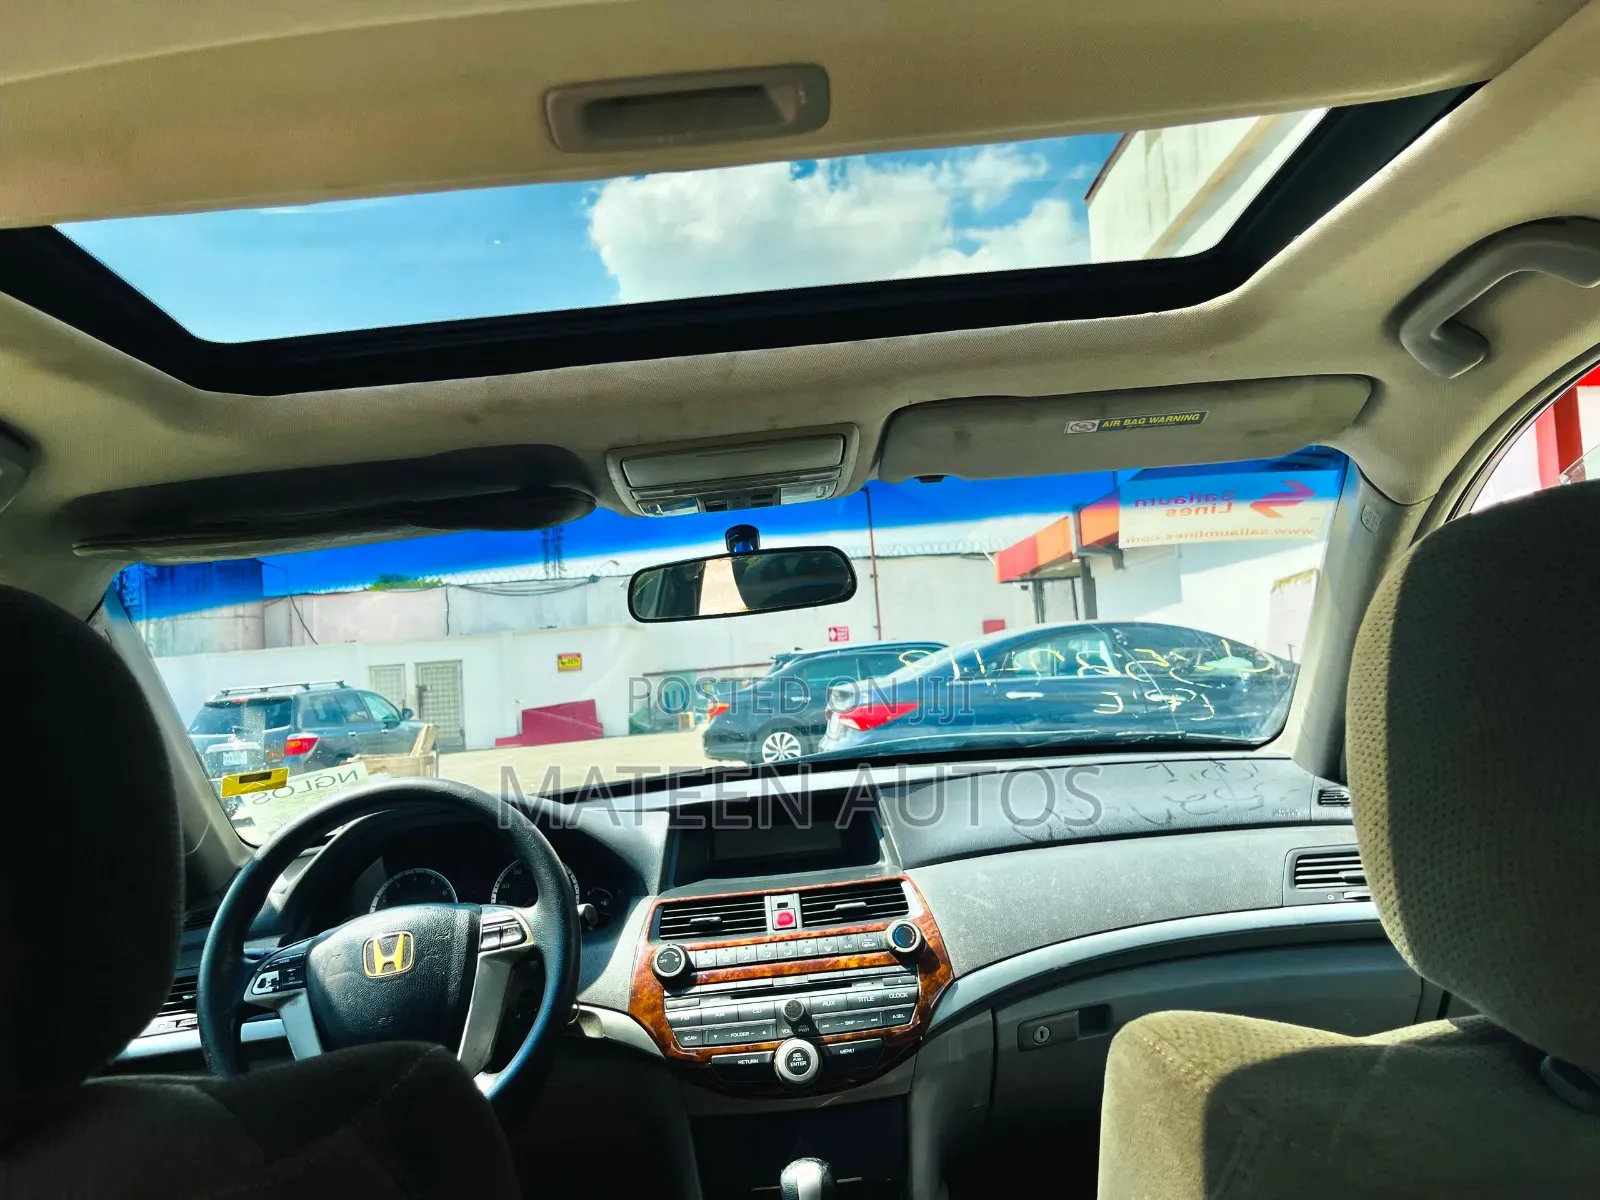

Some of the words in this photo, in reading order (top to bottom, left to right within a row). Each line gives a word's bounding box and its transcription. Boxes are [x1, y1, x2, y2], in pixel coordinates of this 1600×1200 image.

[1101, 420, 1121, 428] AIR
[1123, 417, 1146, 426] BAG
[1149, 413, 1200, 424] WARNING
